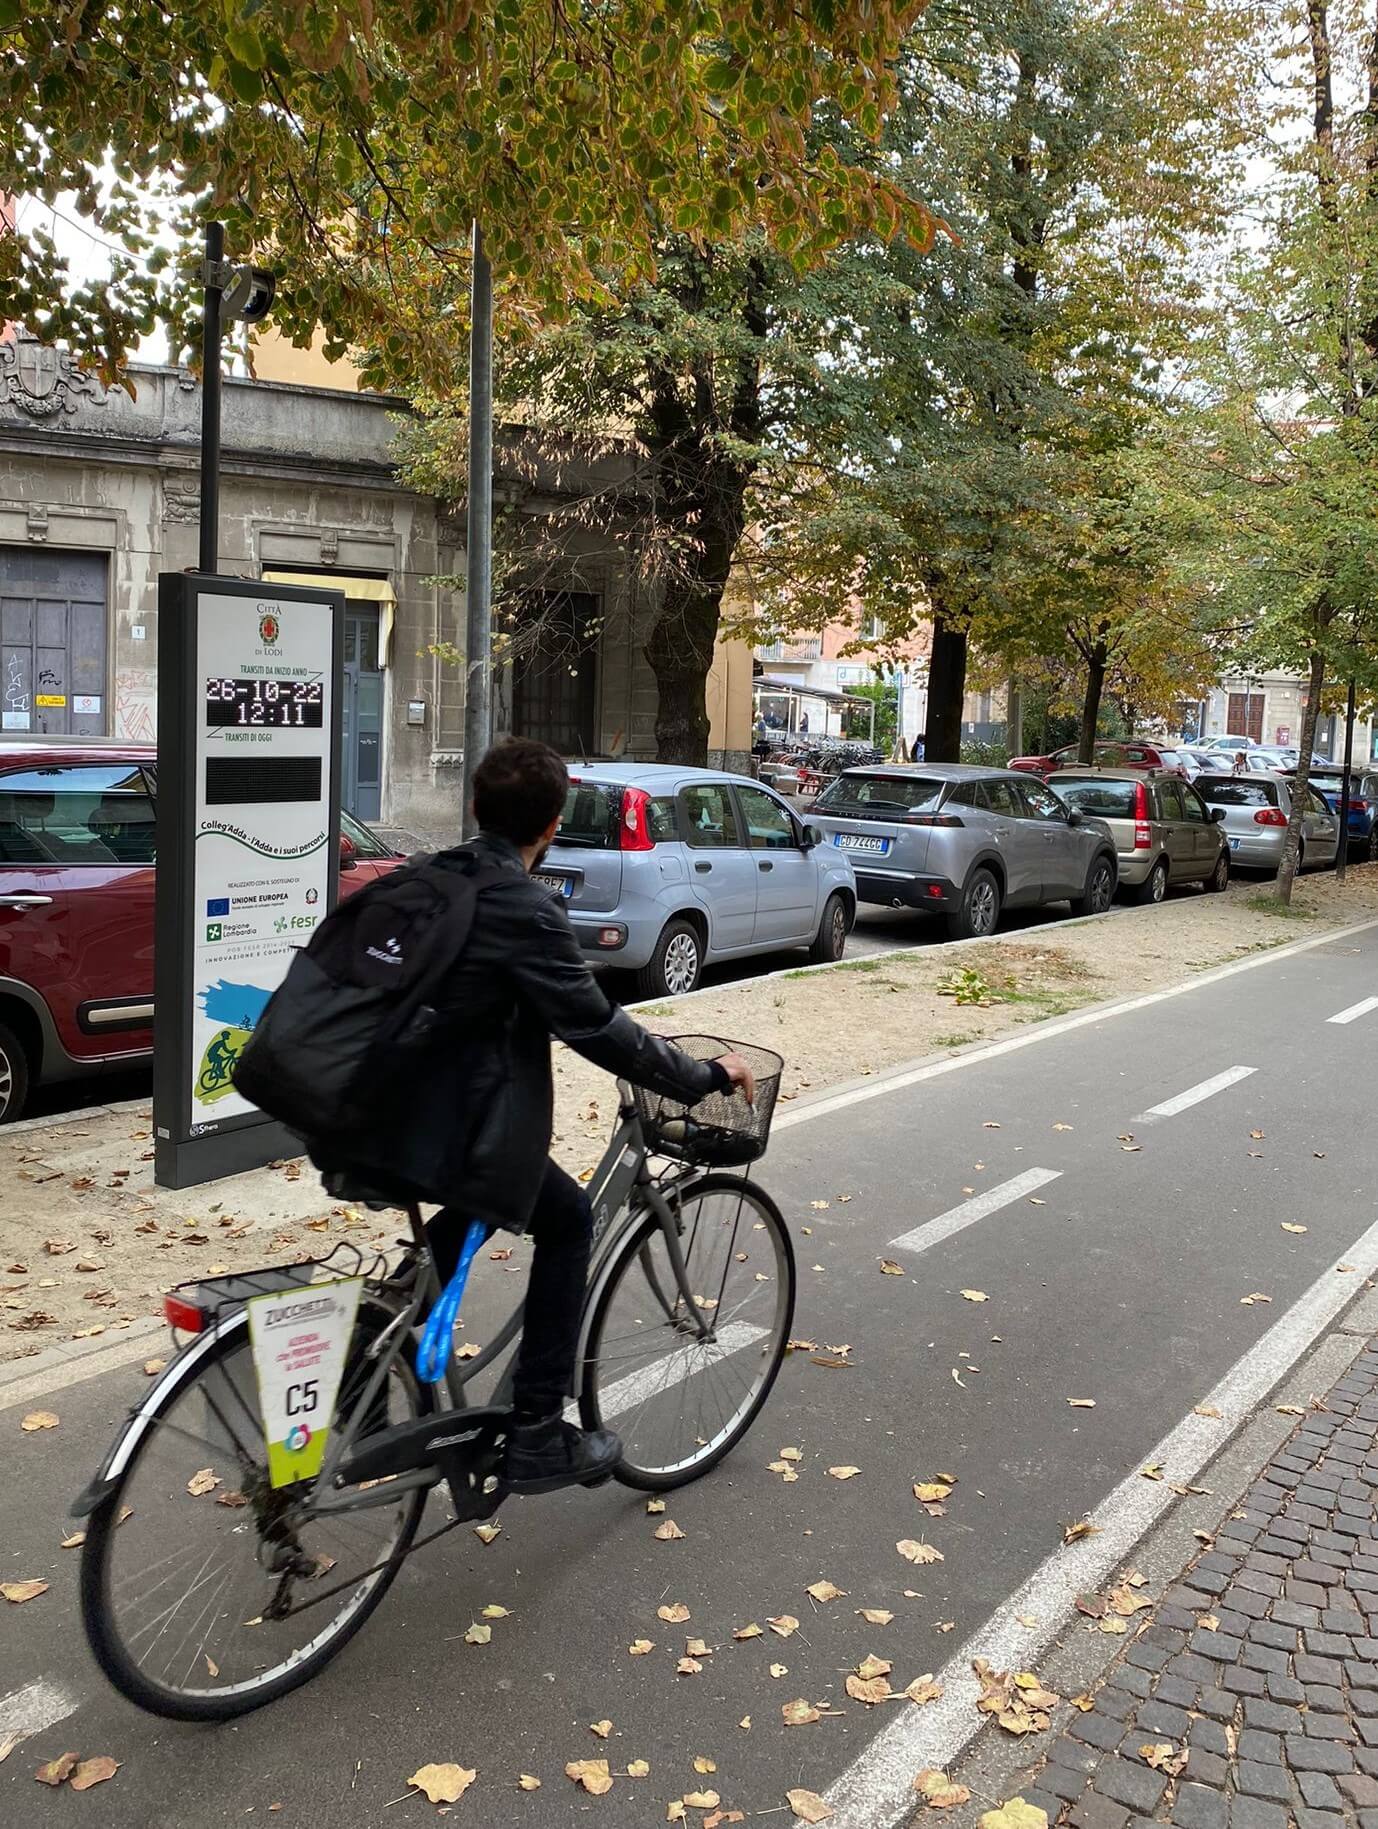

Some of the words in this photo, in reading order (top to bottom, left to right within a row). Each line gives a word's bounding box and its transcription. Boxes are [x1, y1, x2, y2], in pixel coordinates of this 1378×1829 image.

[264, 648, 283, 656] LODI
[240, 664, 265, 674] TRANSITI
[266, 666, 274, 675] DA
[274, 667, 292, 676] INIZIO
[292, 668, 308, 676] ANNO
[207, 679, 321, 703] 26-10-22
[238, 702, 305, 725] 12:11
[225, 733, 250, 742] TRANSITI
[250, 733, 258, 742] DI
[258, 733, 272, 742] OGGI
[201, 820, 247, 841] Colleg'Adda
[251, 836, 273, 853] l'Adda
[279, 846, 282, 855] i
[283, 845, 298, 855] suoi
[299, 830, 326, 854] percorsi
[232, 894, 258, 904] UNIONE
[259, 892, 288, 902] EUROPEA
[223, 922, 250, 932] Regione
[290, 916, 318, 928] fesr
[223, 928, 257, 938] Lombardia
[206, 953, 254, 964] INNOVAZIONE
[287, 1379, 318, 1416] C5
